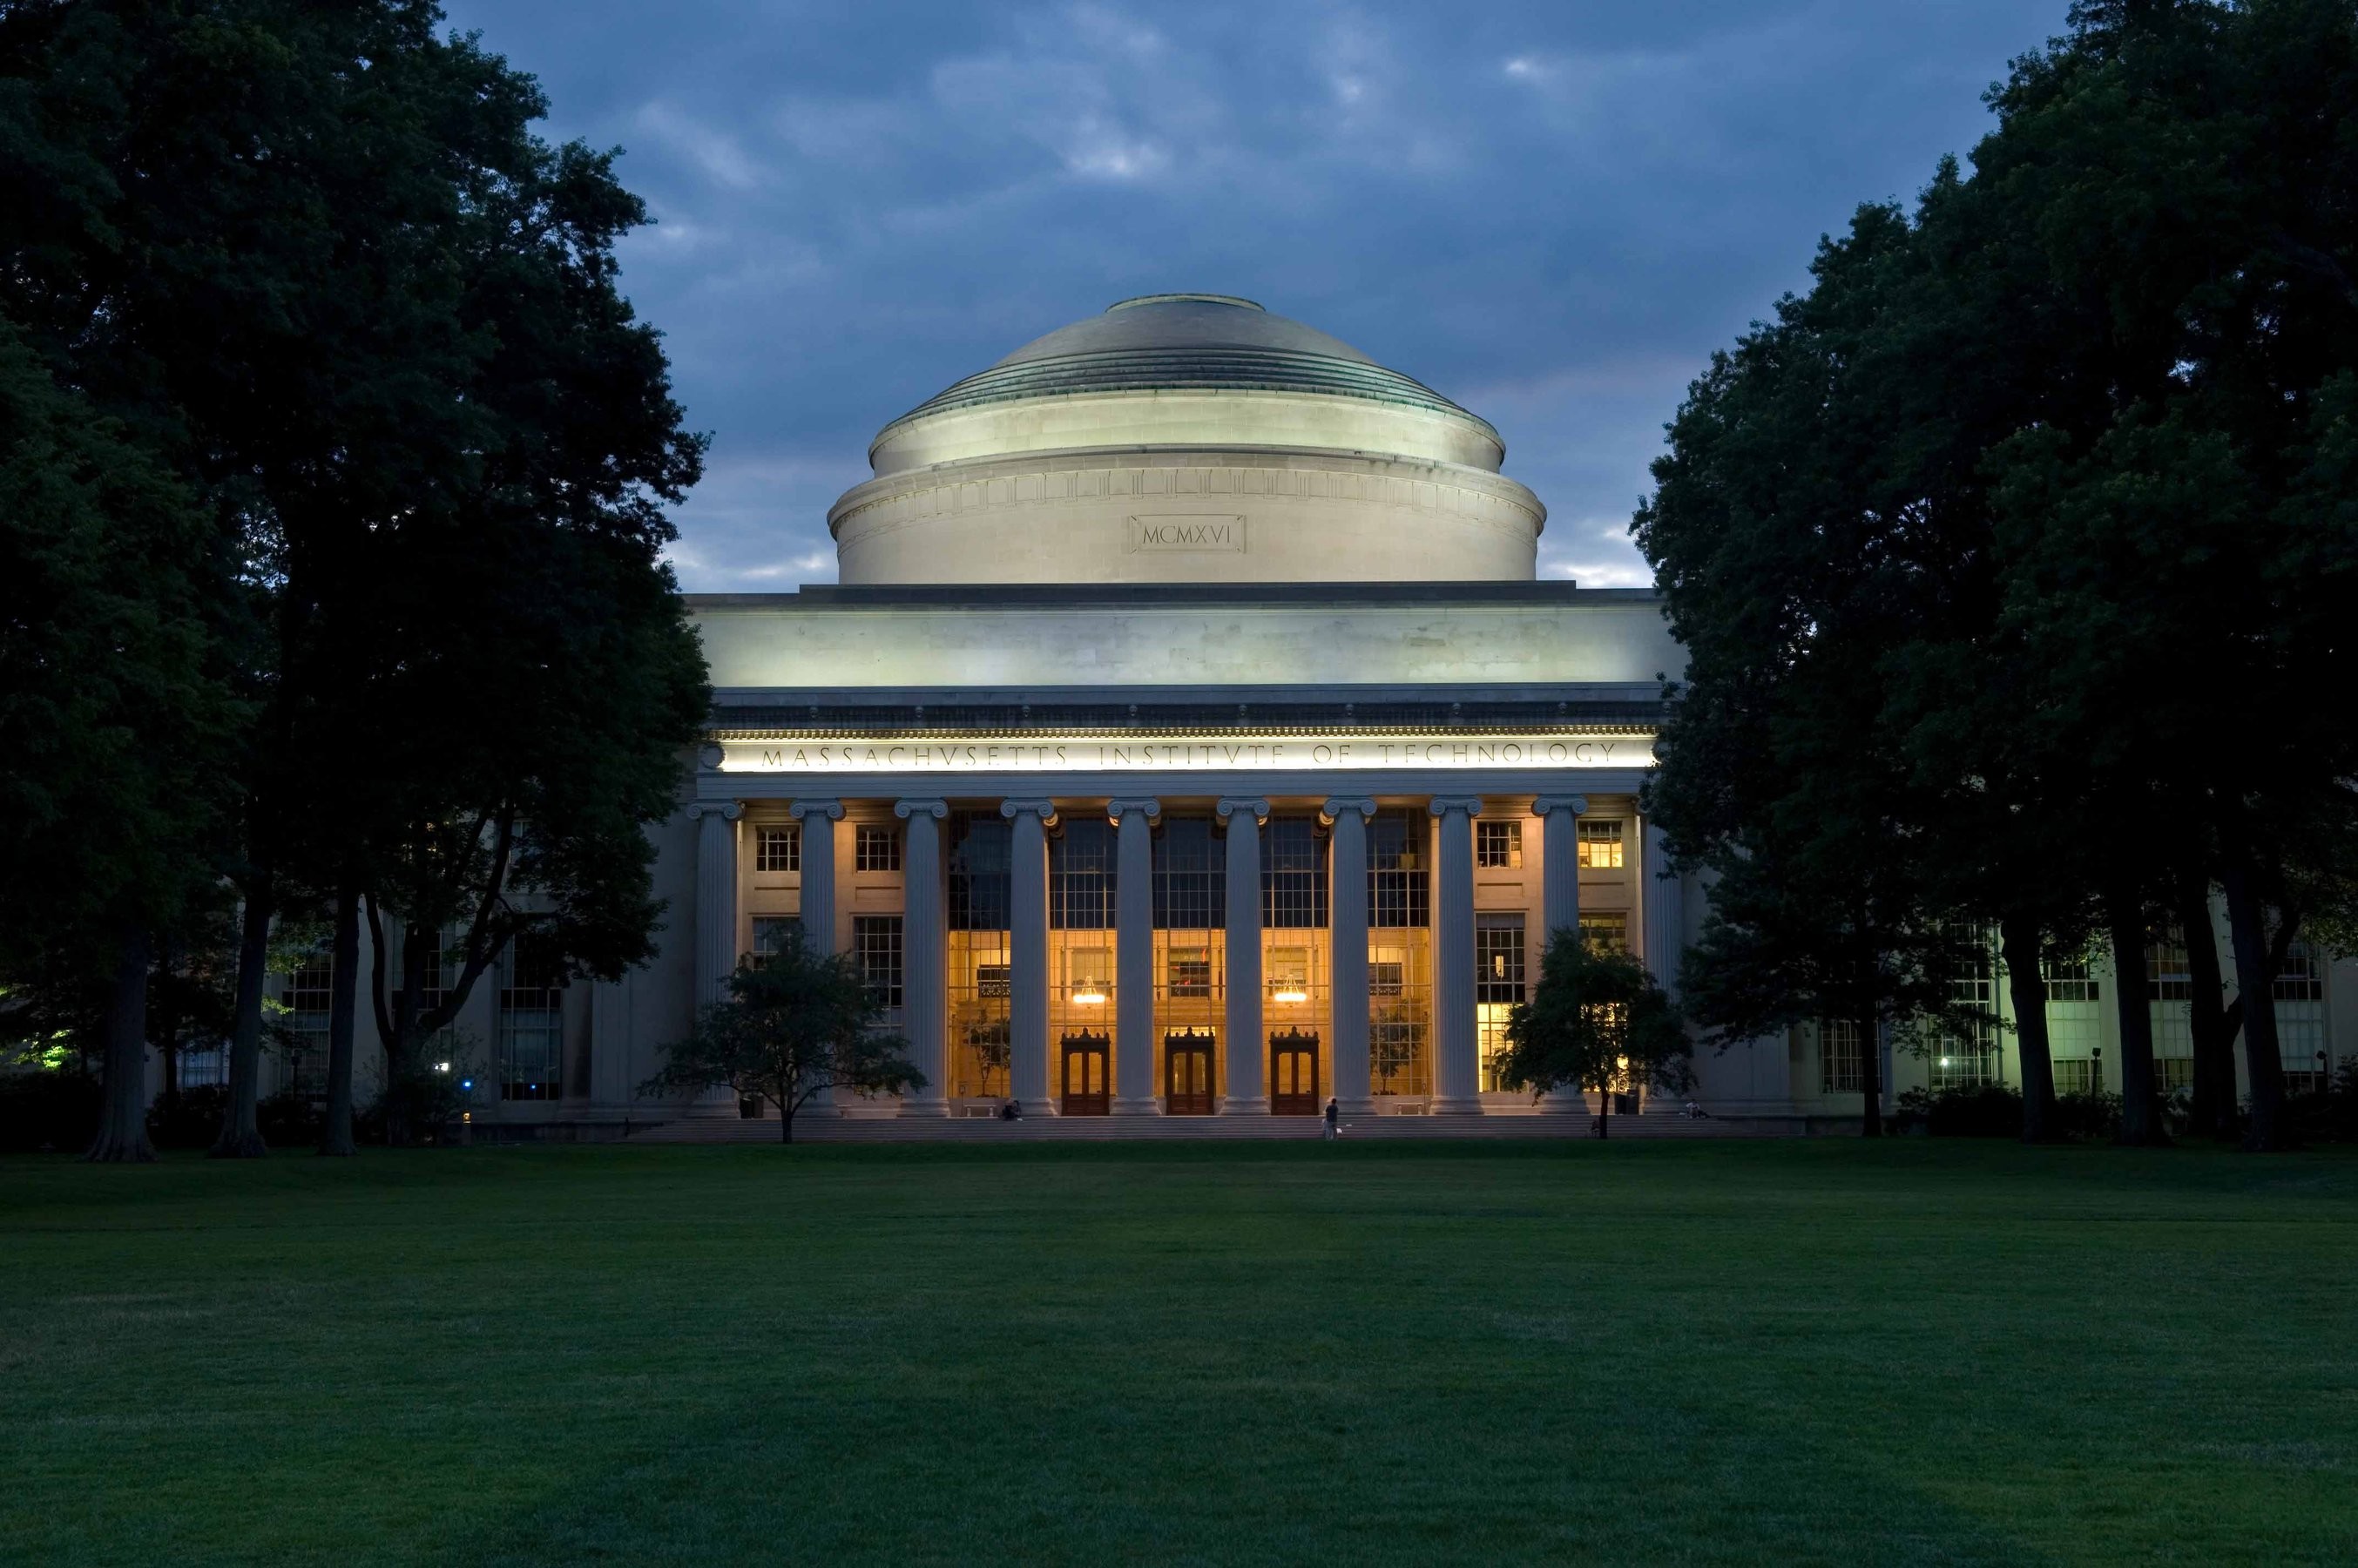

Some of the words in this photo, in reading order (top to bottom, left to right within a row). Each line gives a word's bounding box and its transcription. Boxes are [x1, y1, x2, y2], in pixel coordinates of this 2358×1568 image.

[1143, 525, 1230, 544] MCMXVI
[762, 747, 1066, 767] MASSACHVSETTS
[1313, 745, 1350, 764] OF
